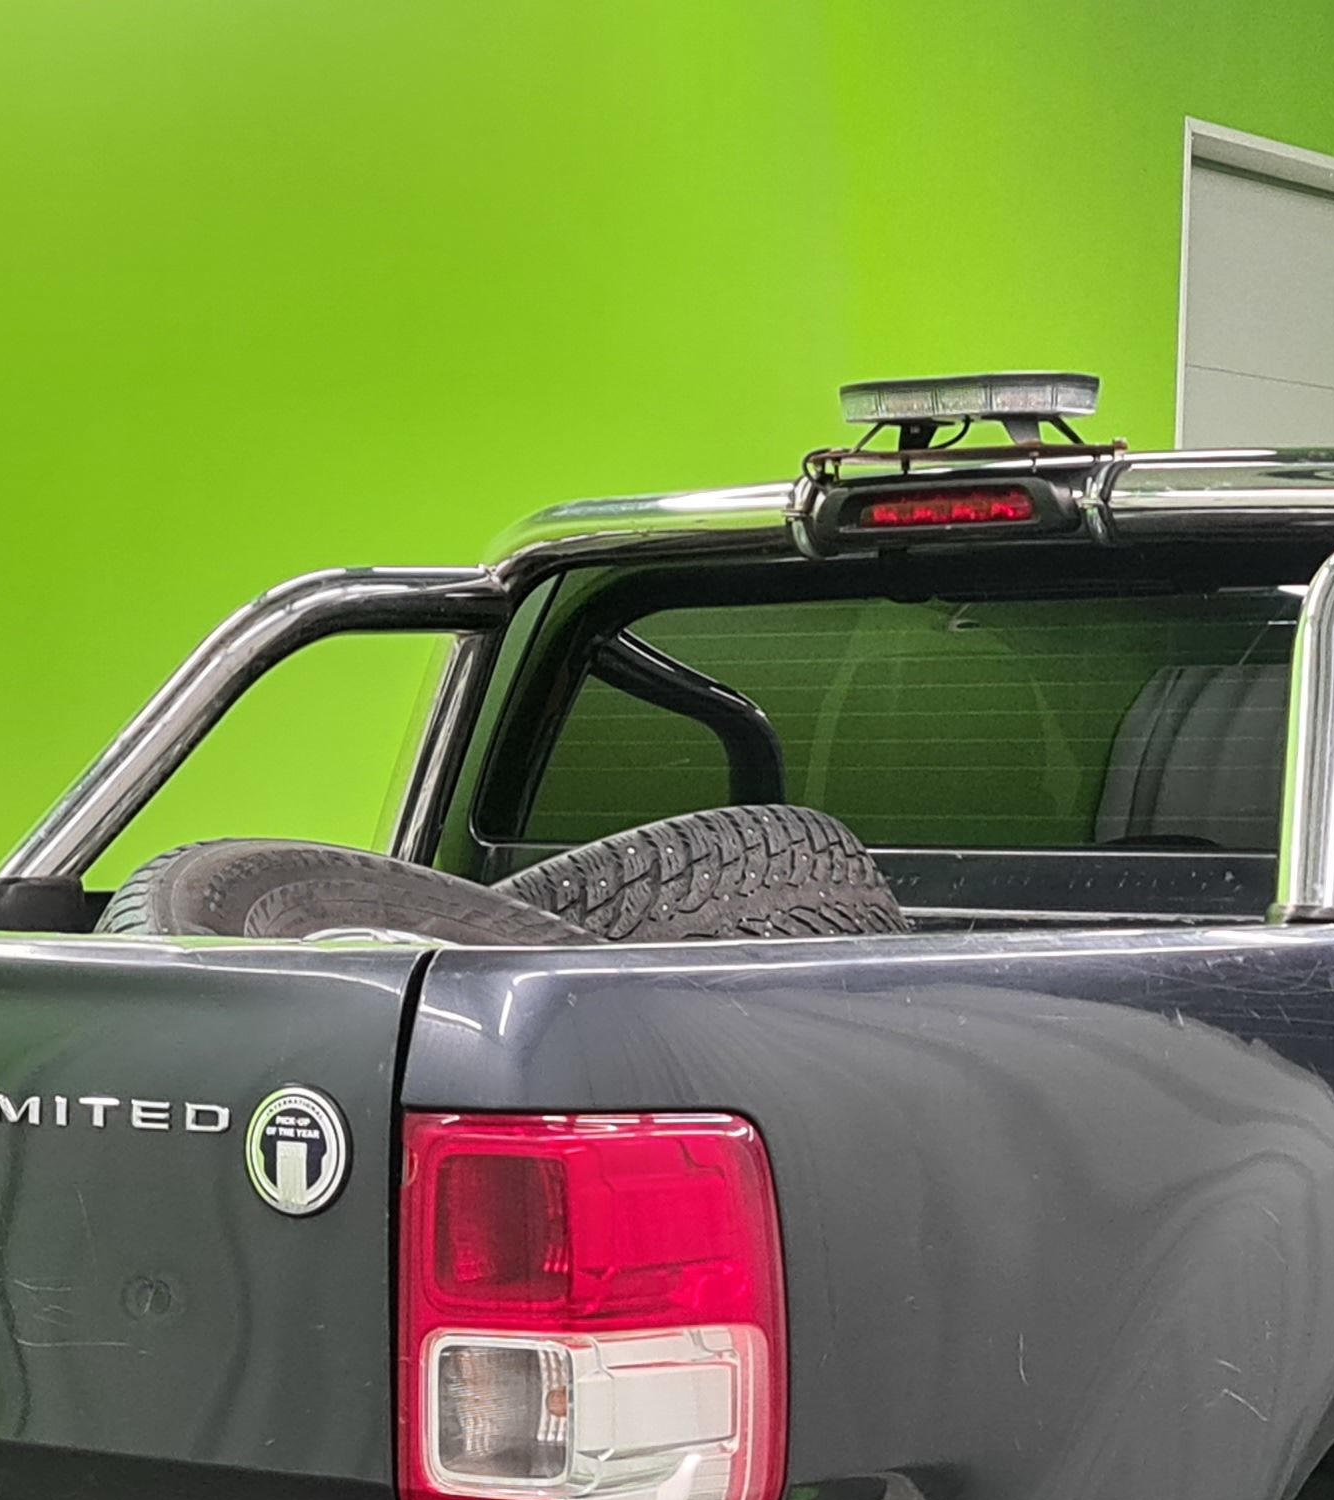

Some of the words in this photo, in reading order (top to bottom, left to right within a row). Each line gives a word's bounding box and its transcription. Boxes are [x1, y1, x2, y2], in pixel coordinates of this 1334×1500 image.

[265, 1126, 278, 1136] OF
[278, 1127, 296, 1138] THE
[296, 1128, 321, 1140] YEAR
